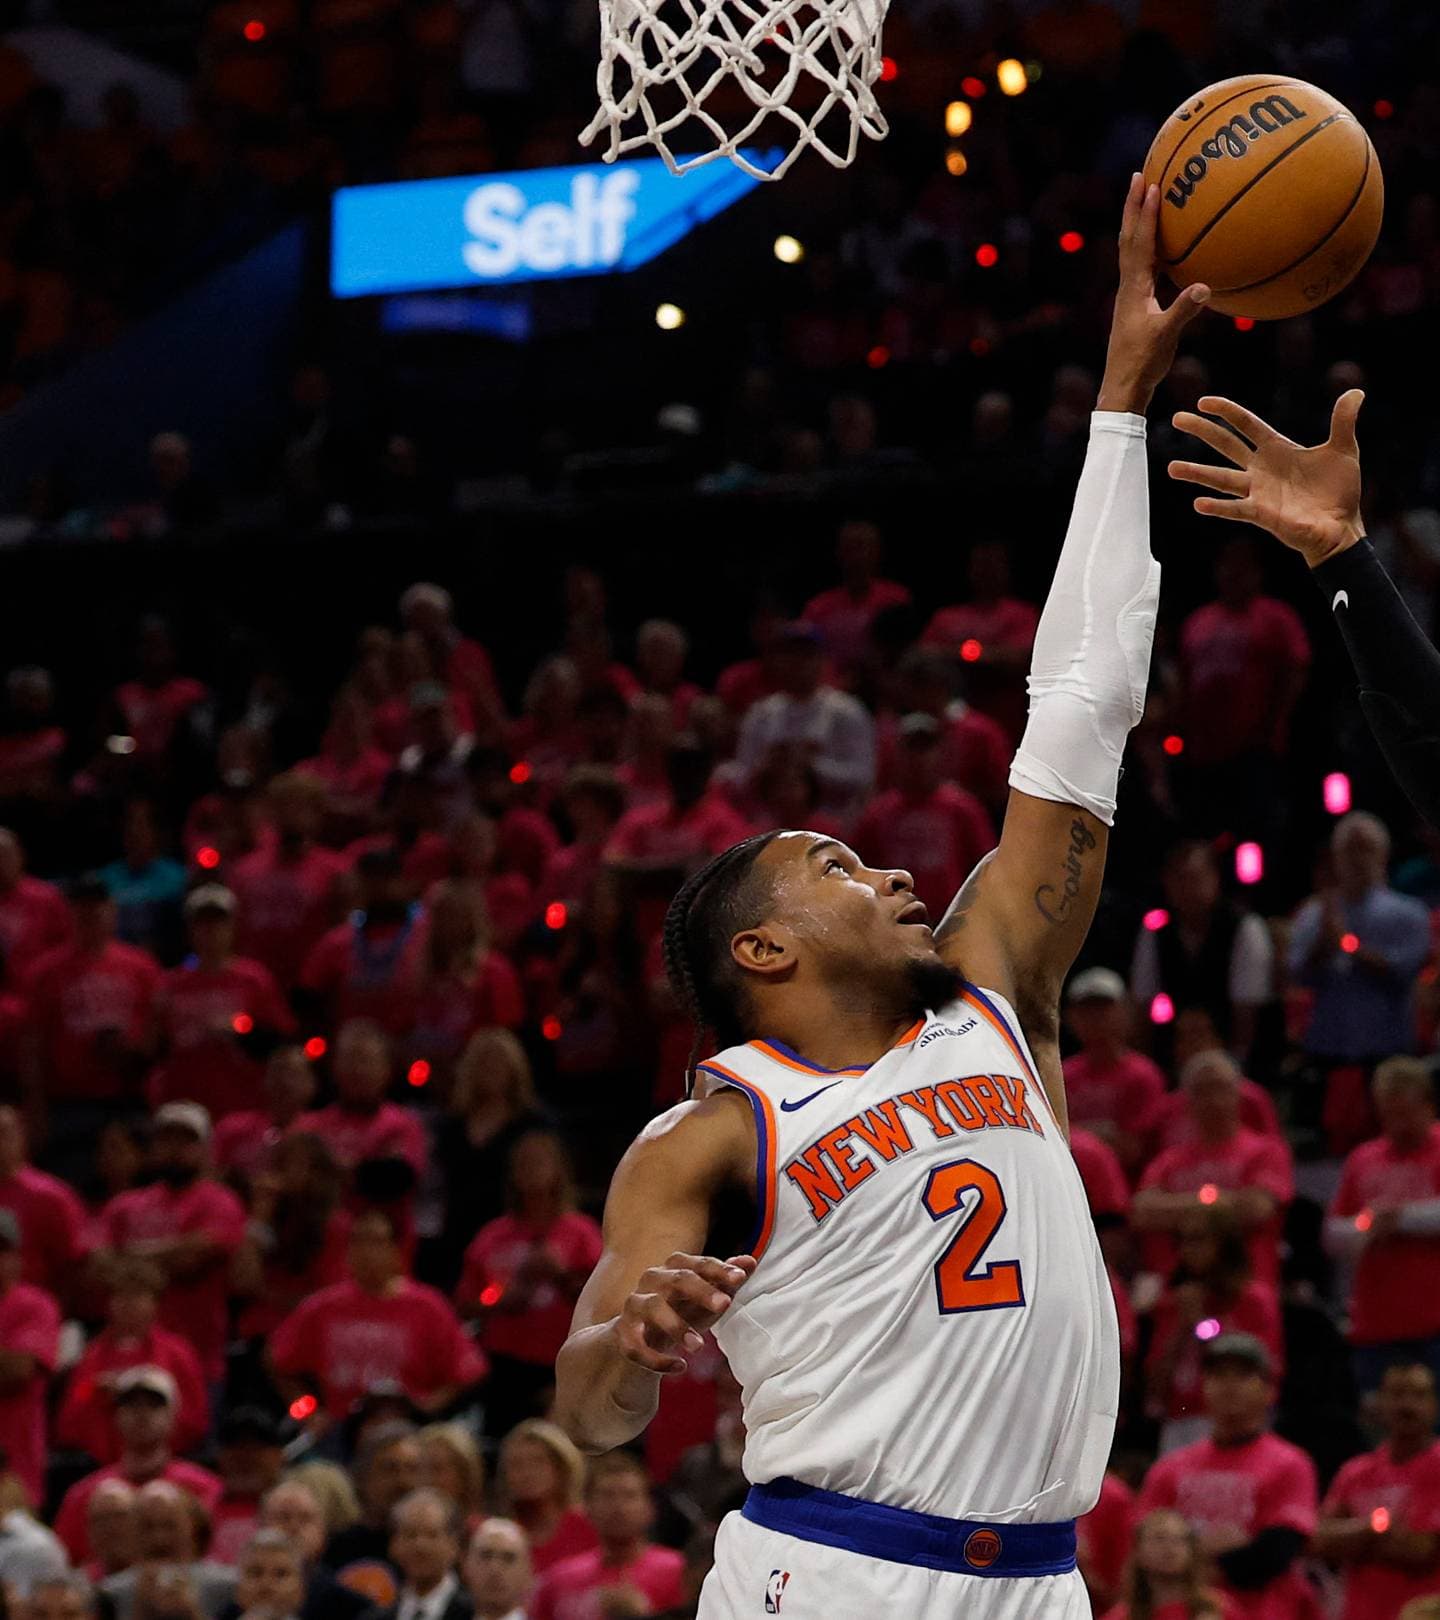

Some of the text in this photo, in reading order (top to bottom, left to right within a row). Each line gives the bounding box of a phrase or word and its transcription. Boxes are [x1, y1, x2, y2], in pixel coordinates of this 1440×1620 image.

[1164, 95, 1306, 209] Wilson
[462, 168, 640, 278] Self
[782, 1073, 1046, 1226] NEW YORK
[921, 1158, 1026, 1315] 2
